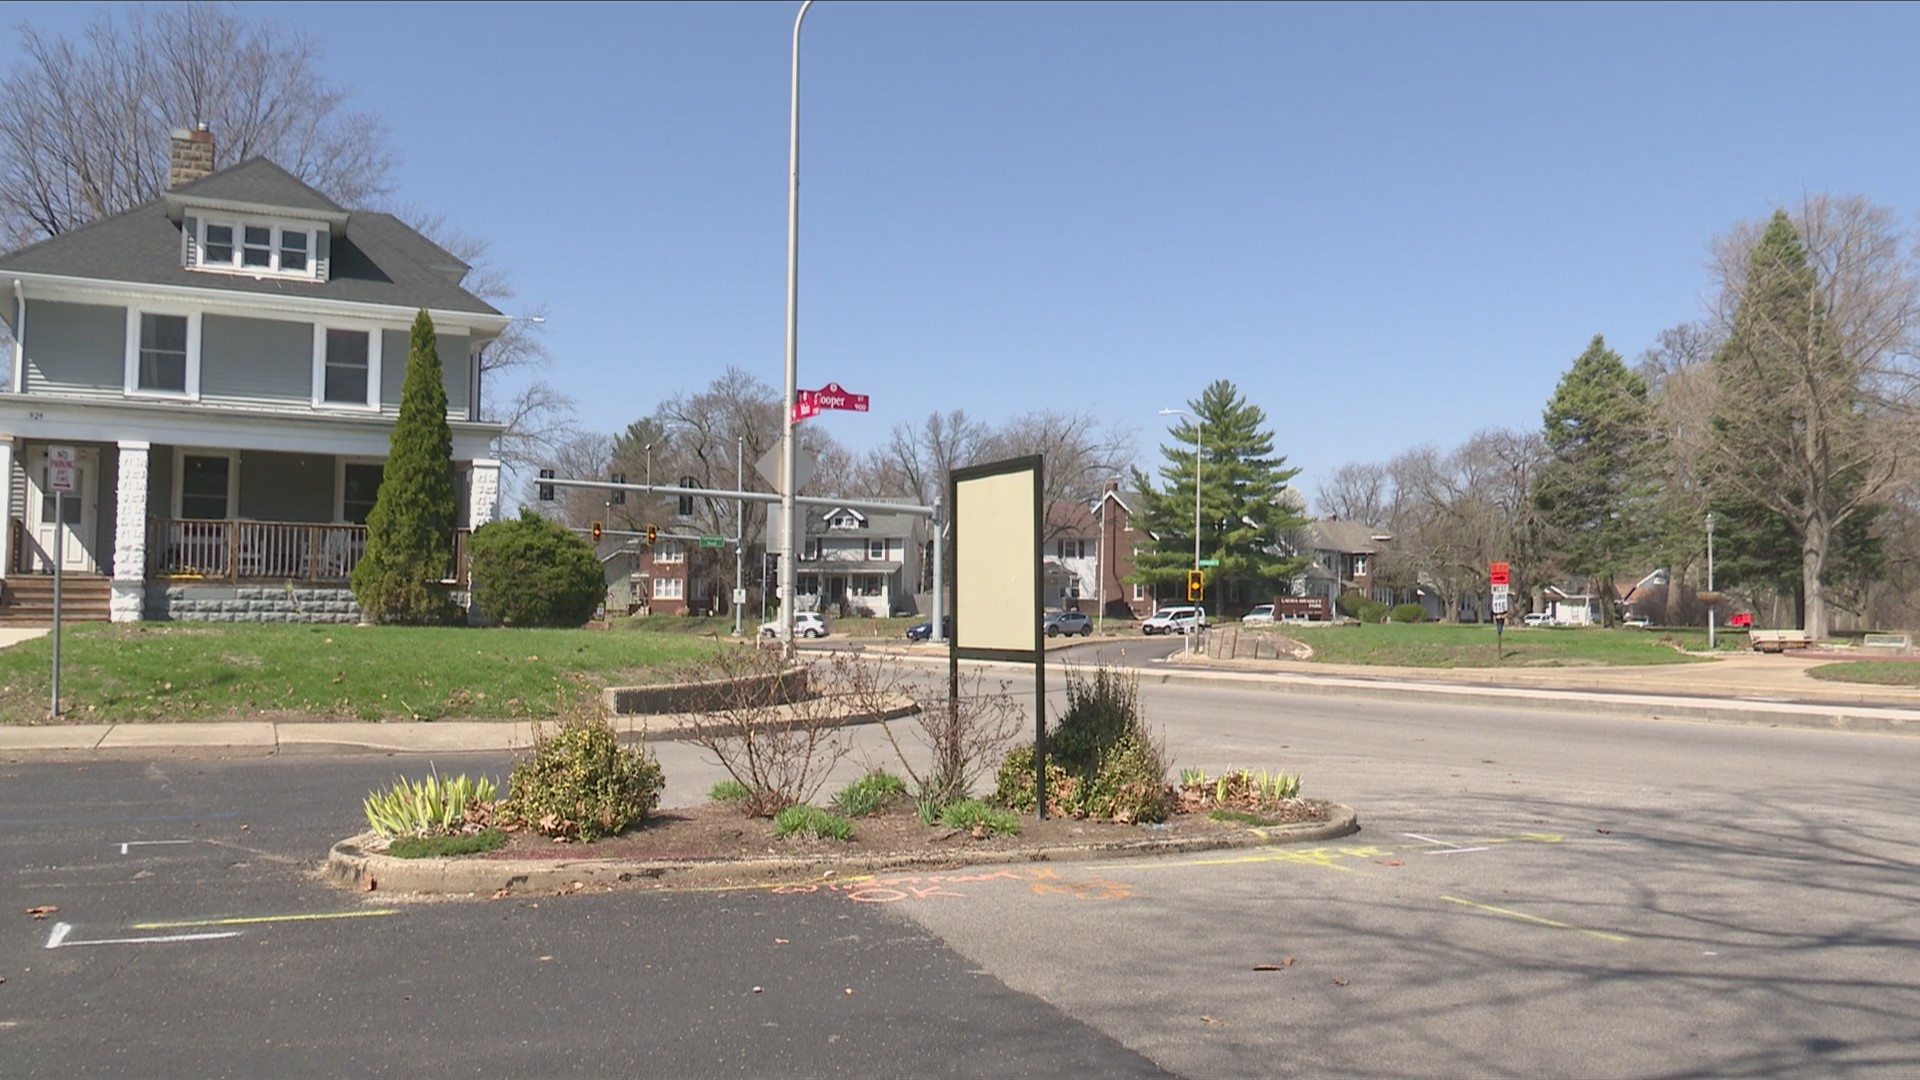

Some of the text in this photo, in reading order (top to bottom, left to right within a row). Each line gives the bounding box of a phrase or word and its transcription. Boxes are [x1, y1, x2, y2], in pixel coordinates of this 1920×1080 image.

[814, 392, 846, 409] Cooper
[57, 450, 69, 460] NO
[50, 459, 76, 469] PARKING
